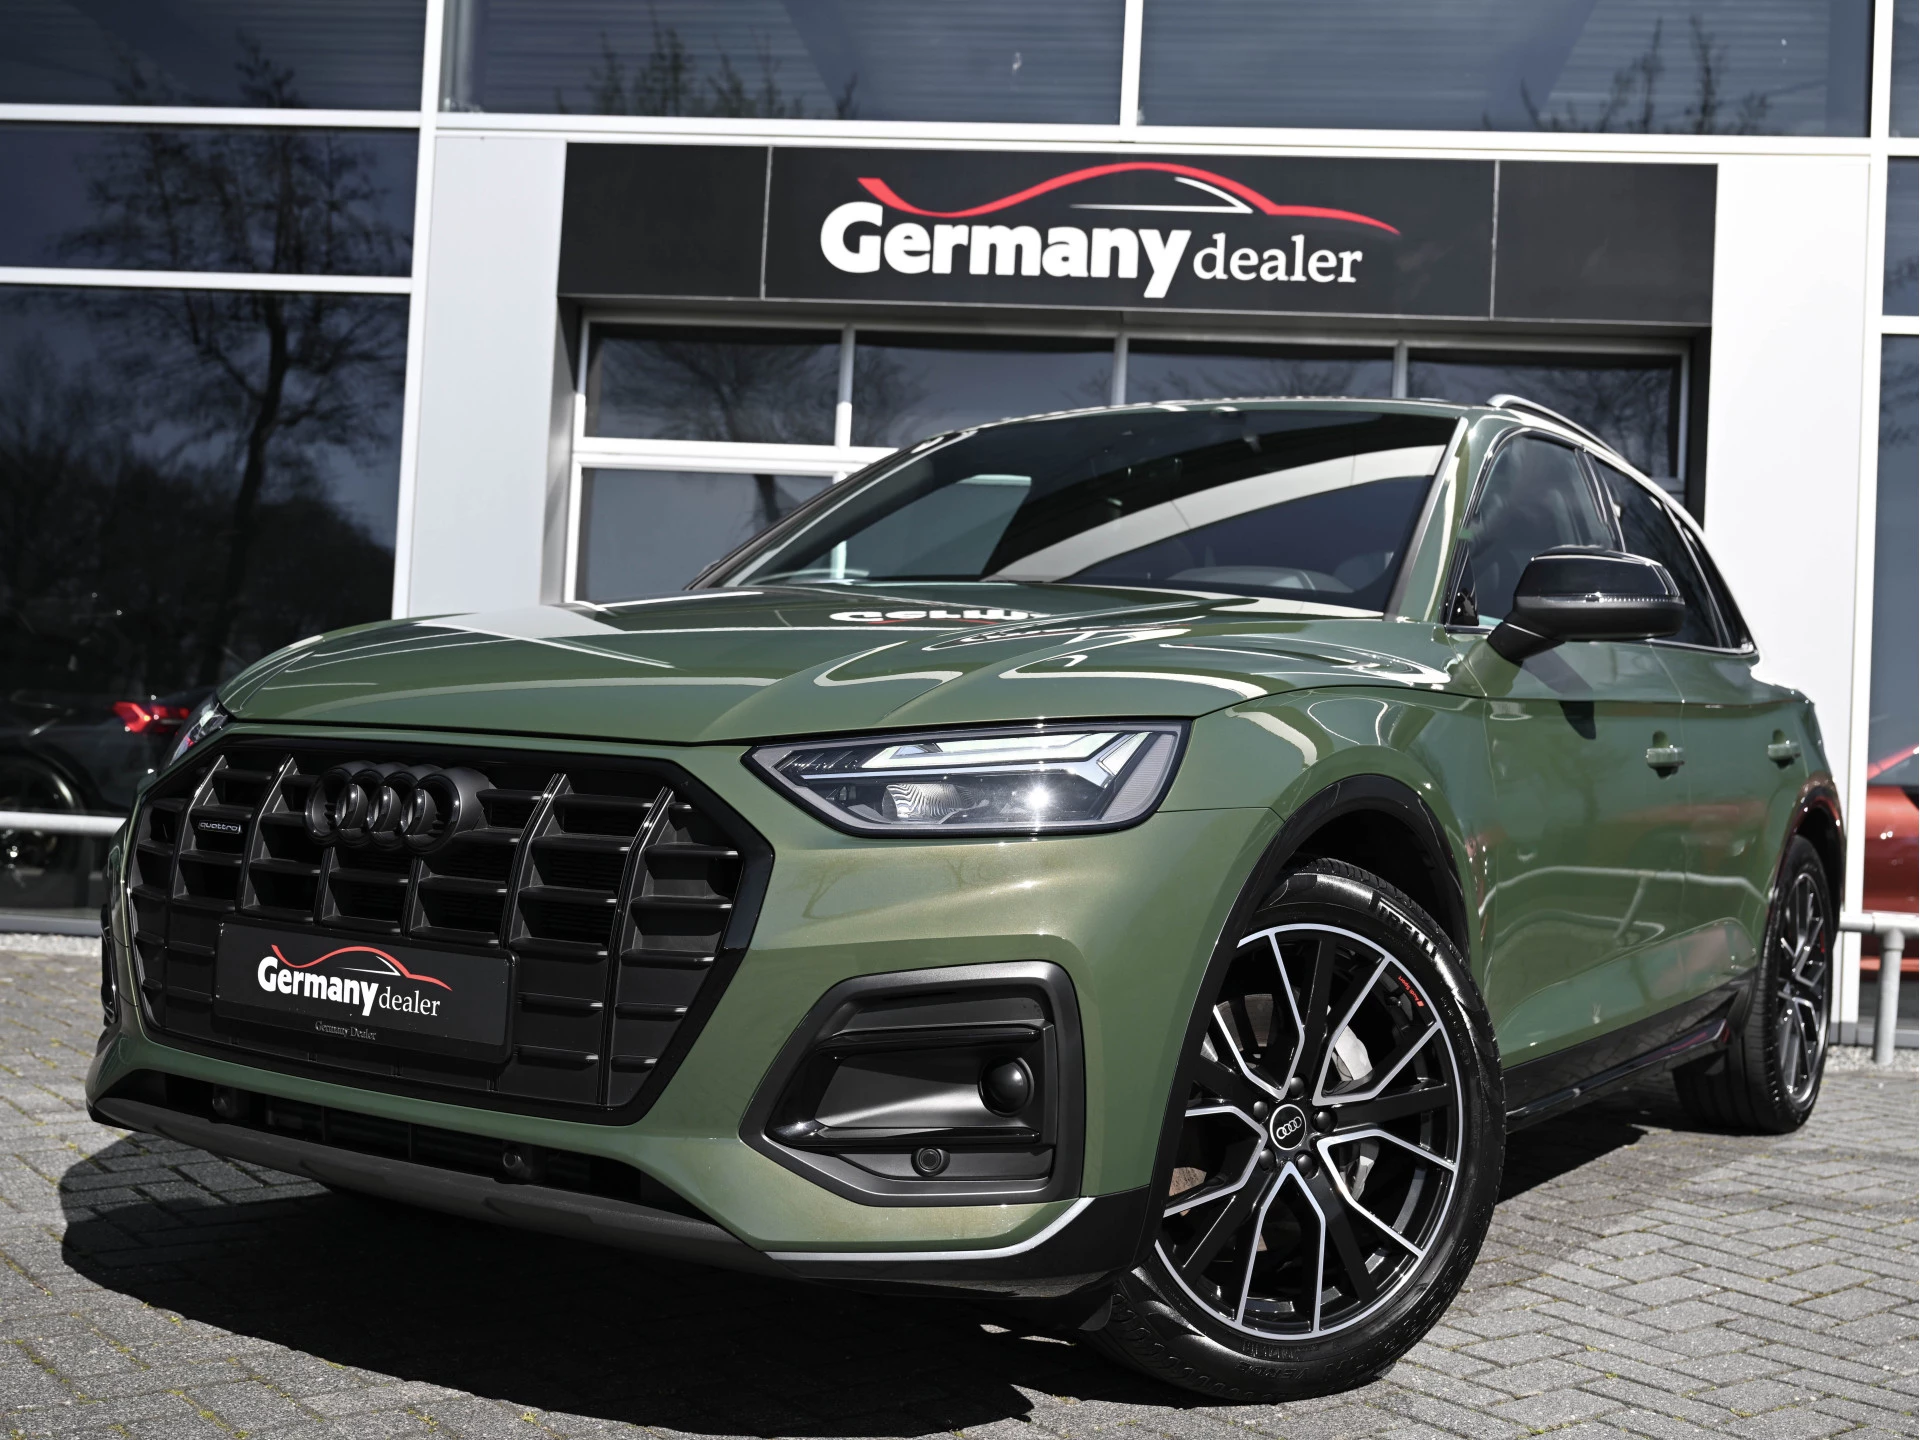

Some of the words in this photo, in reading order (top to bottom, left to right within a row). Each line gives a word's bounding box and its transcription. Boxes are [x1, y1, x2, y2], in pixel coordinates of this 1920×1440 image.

[820, 201, 1191, 298] Germany
[1193, 232, 1363, 284] dealer
[200, 822, 238, 831] quattro
[257, 956, 379, 1017] Germany
[379, 986, 440, 1016] dealer
[315, 1020, 349, 1038] Germany
[350, 1026, 376, 1040] Dealer
